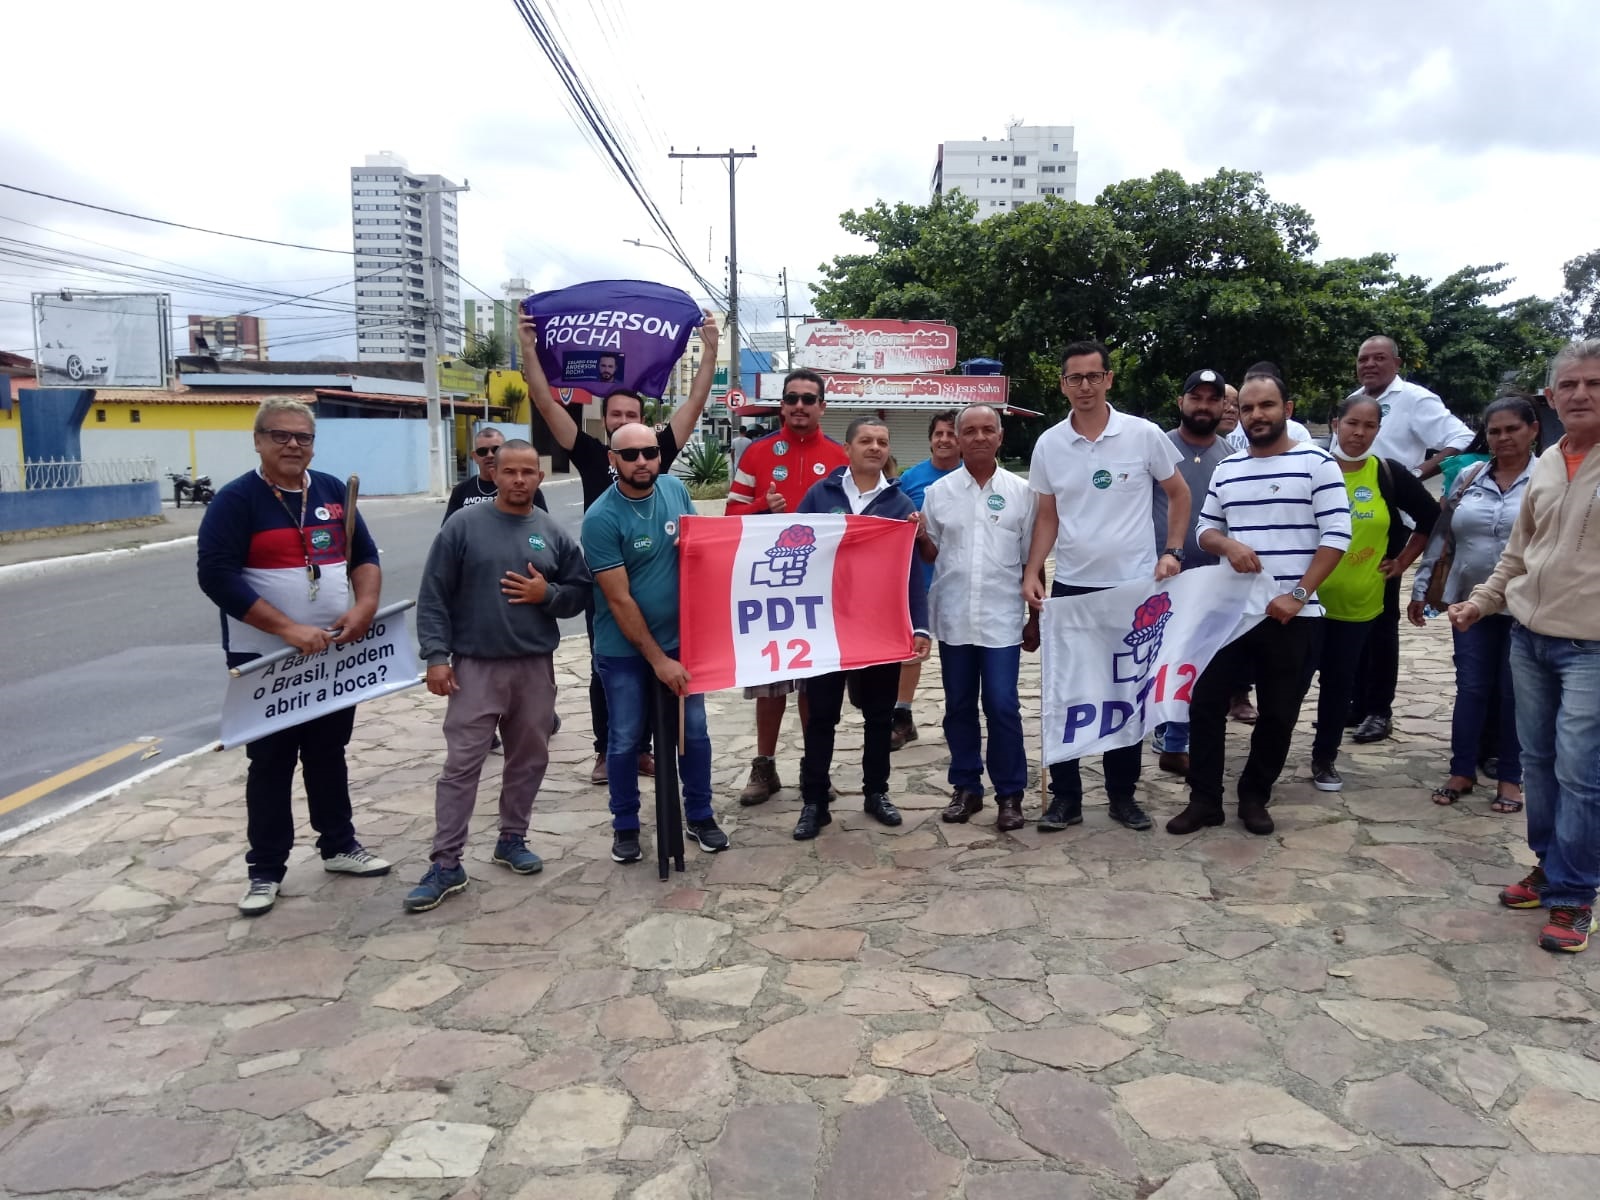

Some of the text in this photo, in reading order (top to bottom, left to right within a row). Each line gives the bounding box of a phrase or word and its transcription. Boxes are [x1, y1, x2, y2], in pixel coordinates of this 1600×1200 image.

[545, 310, 681, 341] ANDERSON
[545, 327, 621, 350] ROCHA
[867, 330, 948, 350] Conquista
[875, 377, 940, 398] Conquista
[943, 383, 955, 393] Só
[956, 383, 977, 393] Jesus
[978, 383, 1001, 393] Salva
[738, 595, 824, 635] PDT
[261, 662, 276, 678] A
[761, 638, 813, 672] 12
[253, 643, 394, 700] o Brasil, podem
[265, 664, 388, 718] abrir a boca?
[1062, 664, 1197, 743] PDT 12
